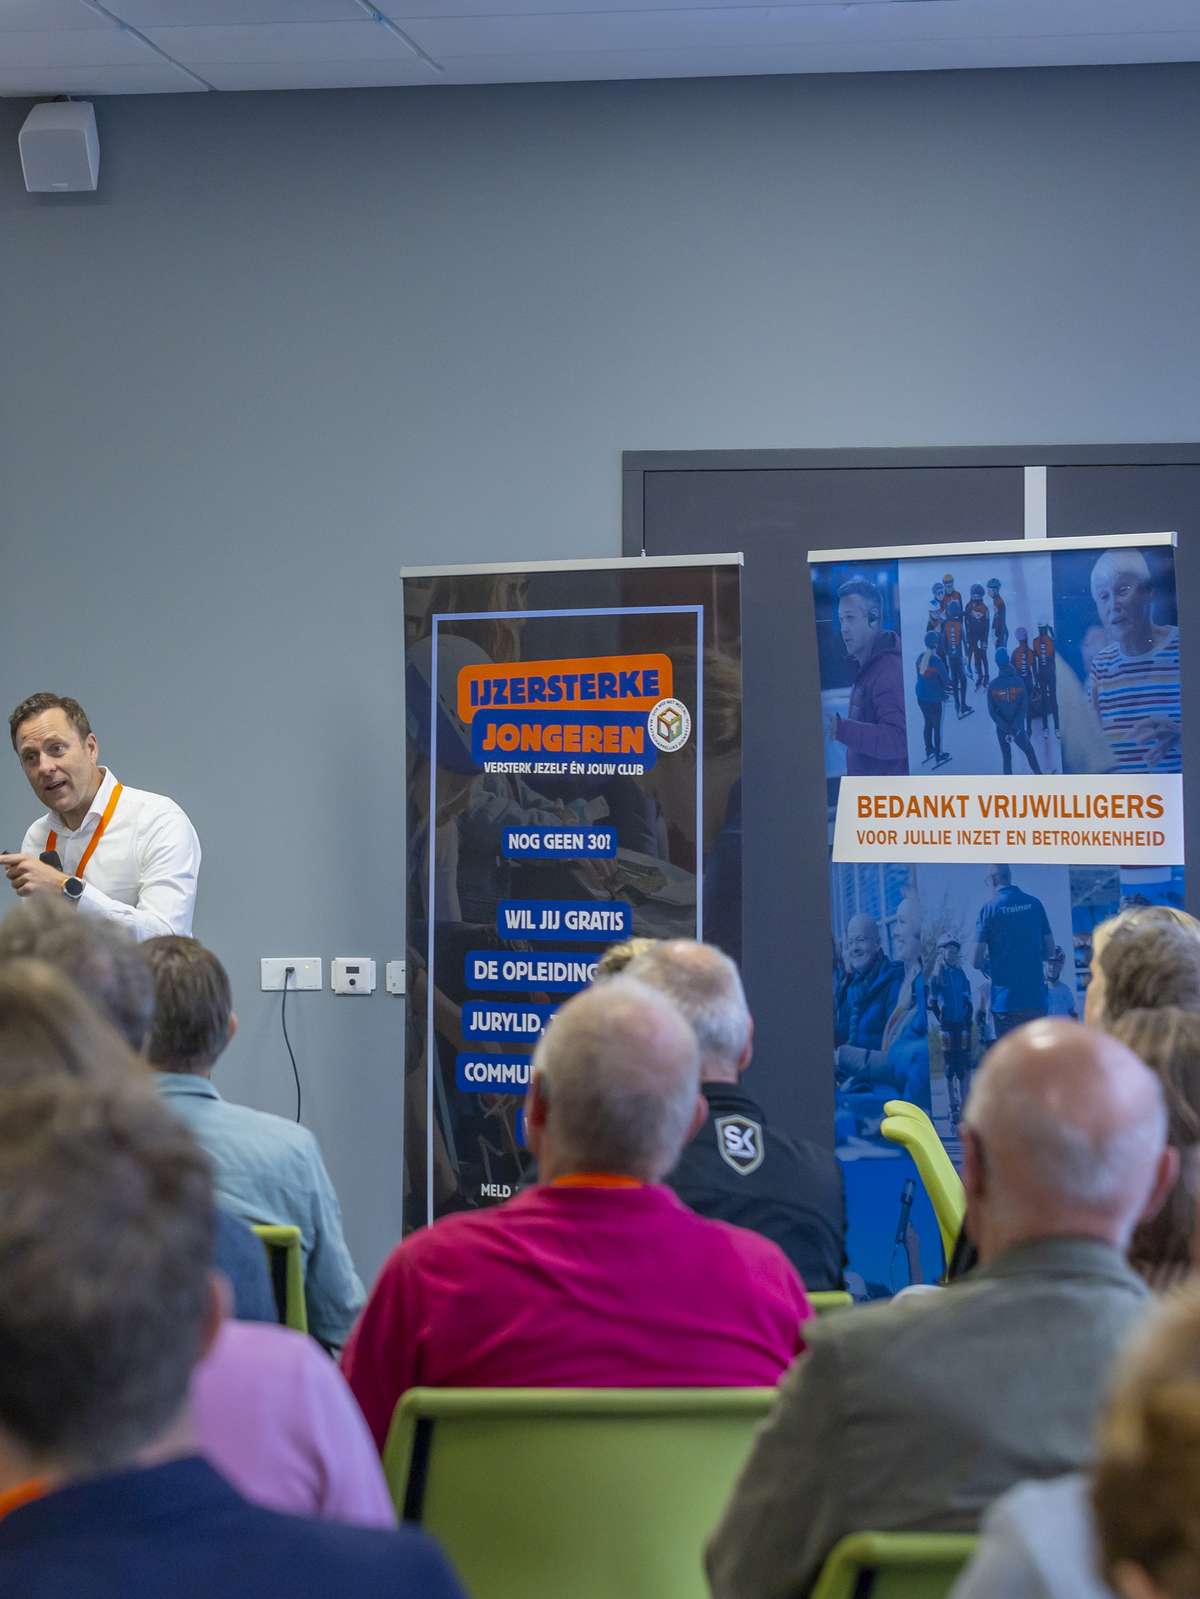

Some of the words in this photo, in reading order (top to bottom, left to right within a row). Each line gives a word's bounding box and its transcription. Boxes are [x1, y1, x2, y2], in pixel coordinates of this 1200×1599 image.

[471, 670, 659, 706] IJZERSTERKE
[482, 723, 645, 754] JONGEREN
[484, 761, 532, 774] VERSTERK
[533, 762, 568, 774] JEZELF
[586, 764, 616, 775] JOUW
[617, 764, 644, 776] CLUB
[856, 795, 970, 818] BEDANKT
[977, 795, 1164, 819] VRIJWILLIGERS
[508, 833, 541, 850] NOG
[543, 834, 584, 850] GEEN
[856, 830, 898, 845] VOOR
[903, 830, 952, 845] JULLIE
[956, 830, 1001, 846] INZET
[1006, 830, 1027, 846] EN
[1032, 830, 1166, 847] BETROKKENHEID
[504, 909, 536, 930] WIL
[539, 910, 561, 930] JIJ
[564, 910, 625, 932] GRATIS
[474, 960, 499, 980] DE
[470, 1011, 545, 1036] JURYLID,
[481, 1183, 512, 1198] MELD
